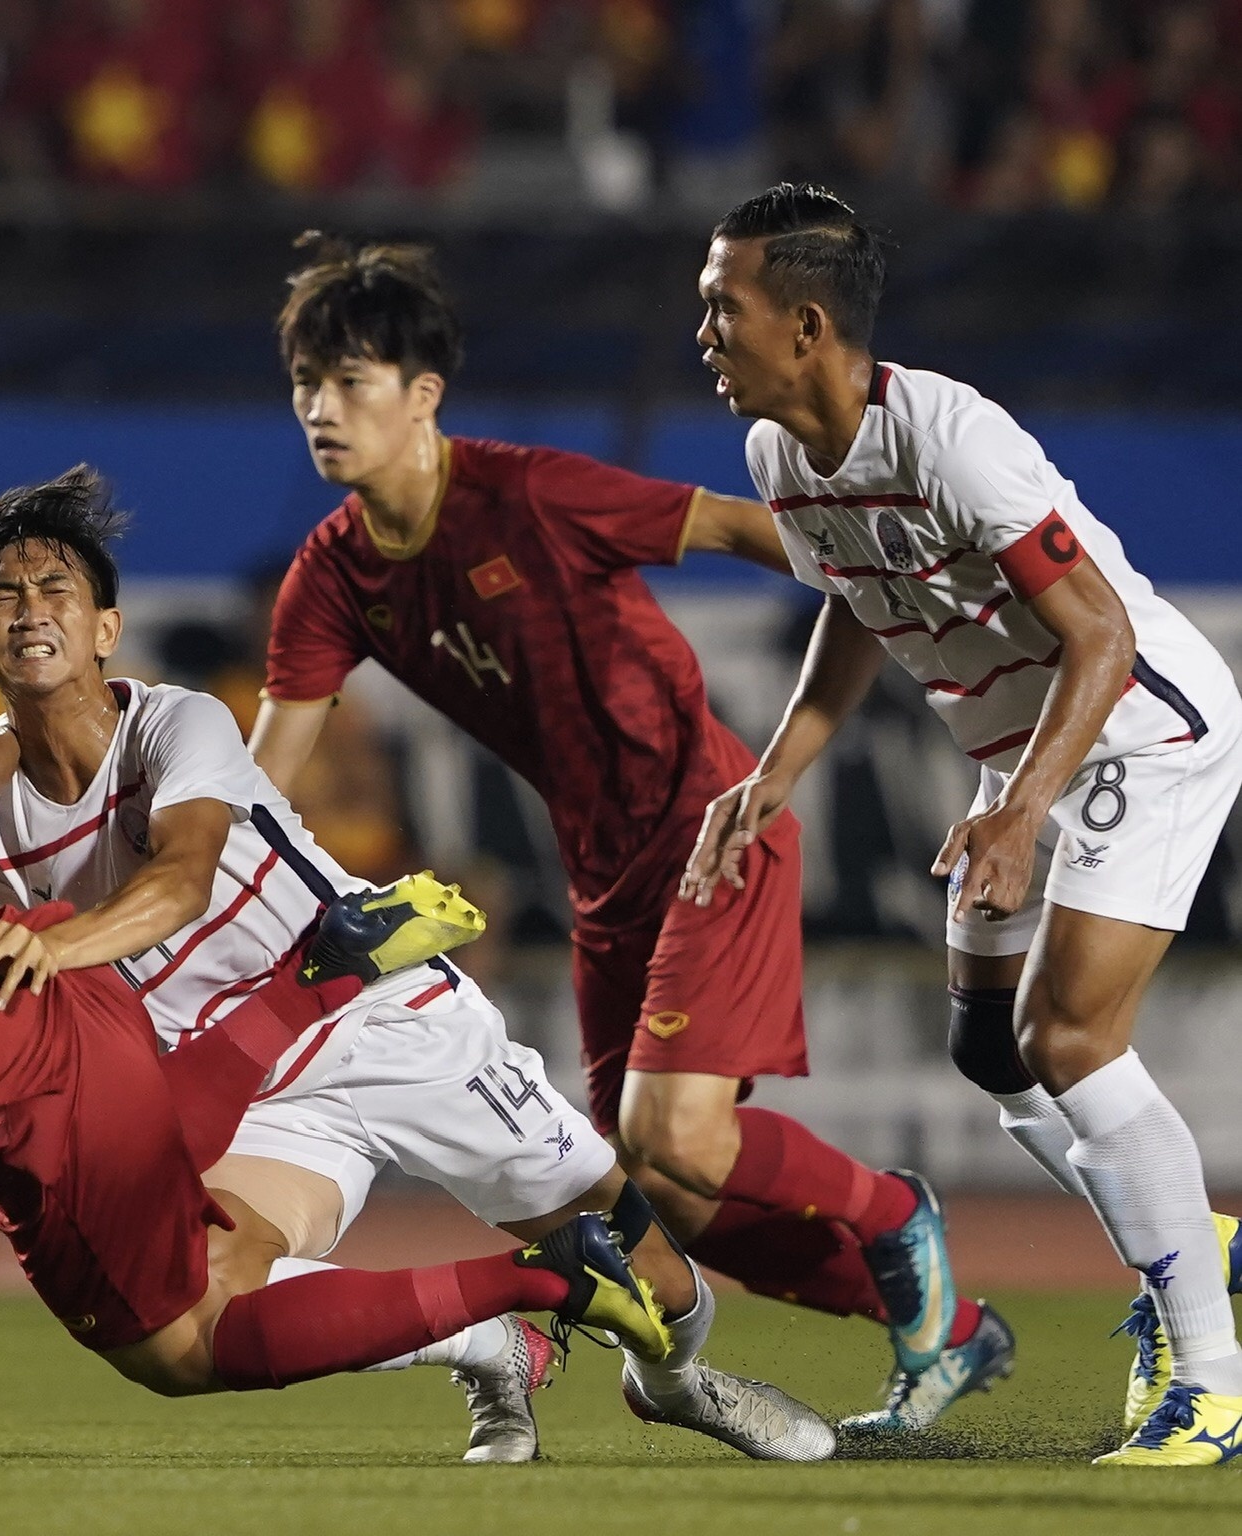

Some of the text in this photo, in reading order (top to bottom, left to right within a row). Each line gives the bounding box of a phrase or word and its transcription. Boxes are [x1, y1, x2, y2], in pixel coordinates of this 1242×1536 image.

[1041, 520, 1078, 564] C
[430, 621, 512, 688] 14
[1081, 759, 1126, 832] 8
[1070, 855, 1105, 869] FBT
[466, 1061, 553, 1143] 14
[558, 1132, 575, 1161] FBT
